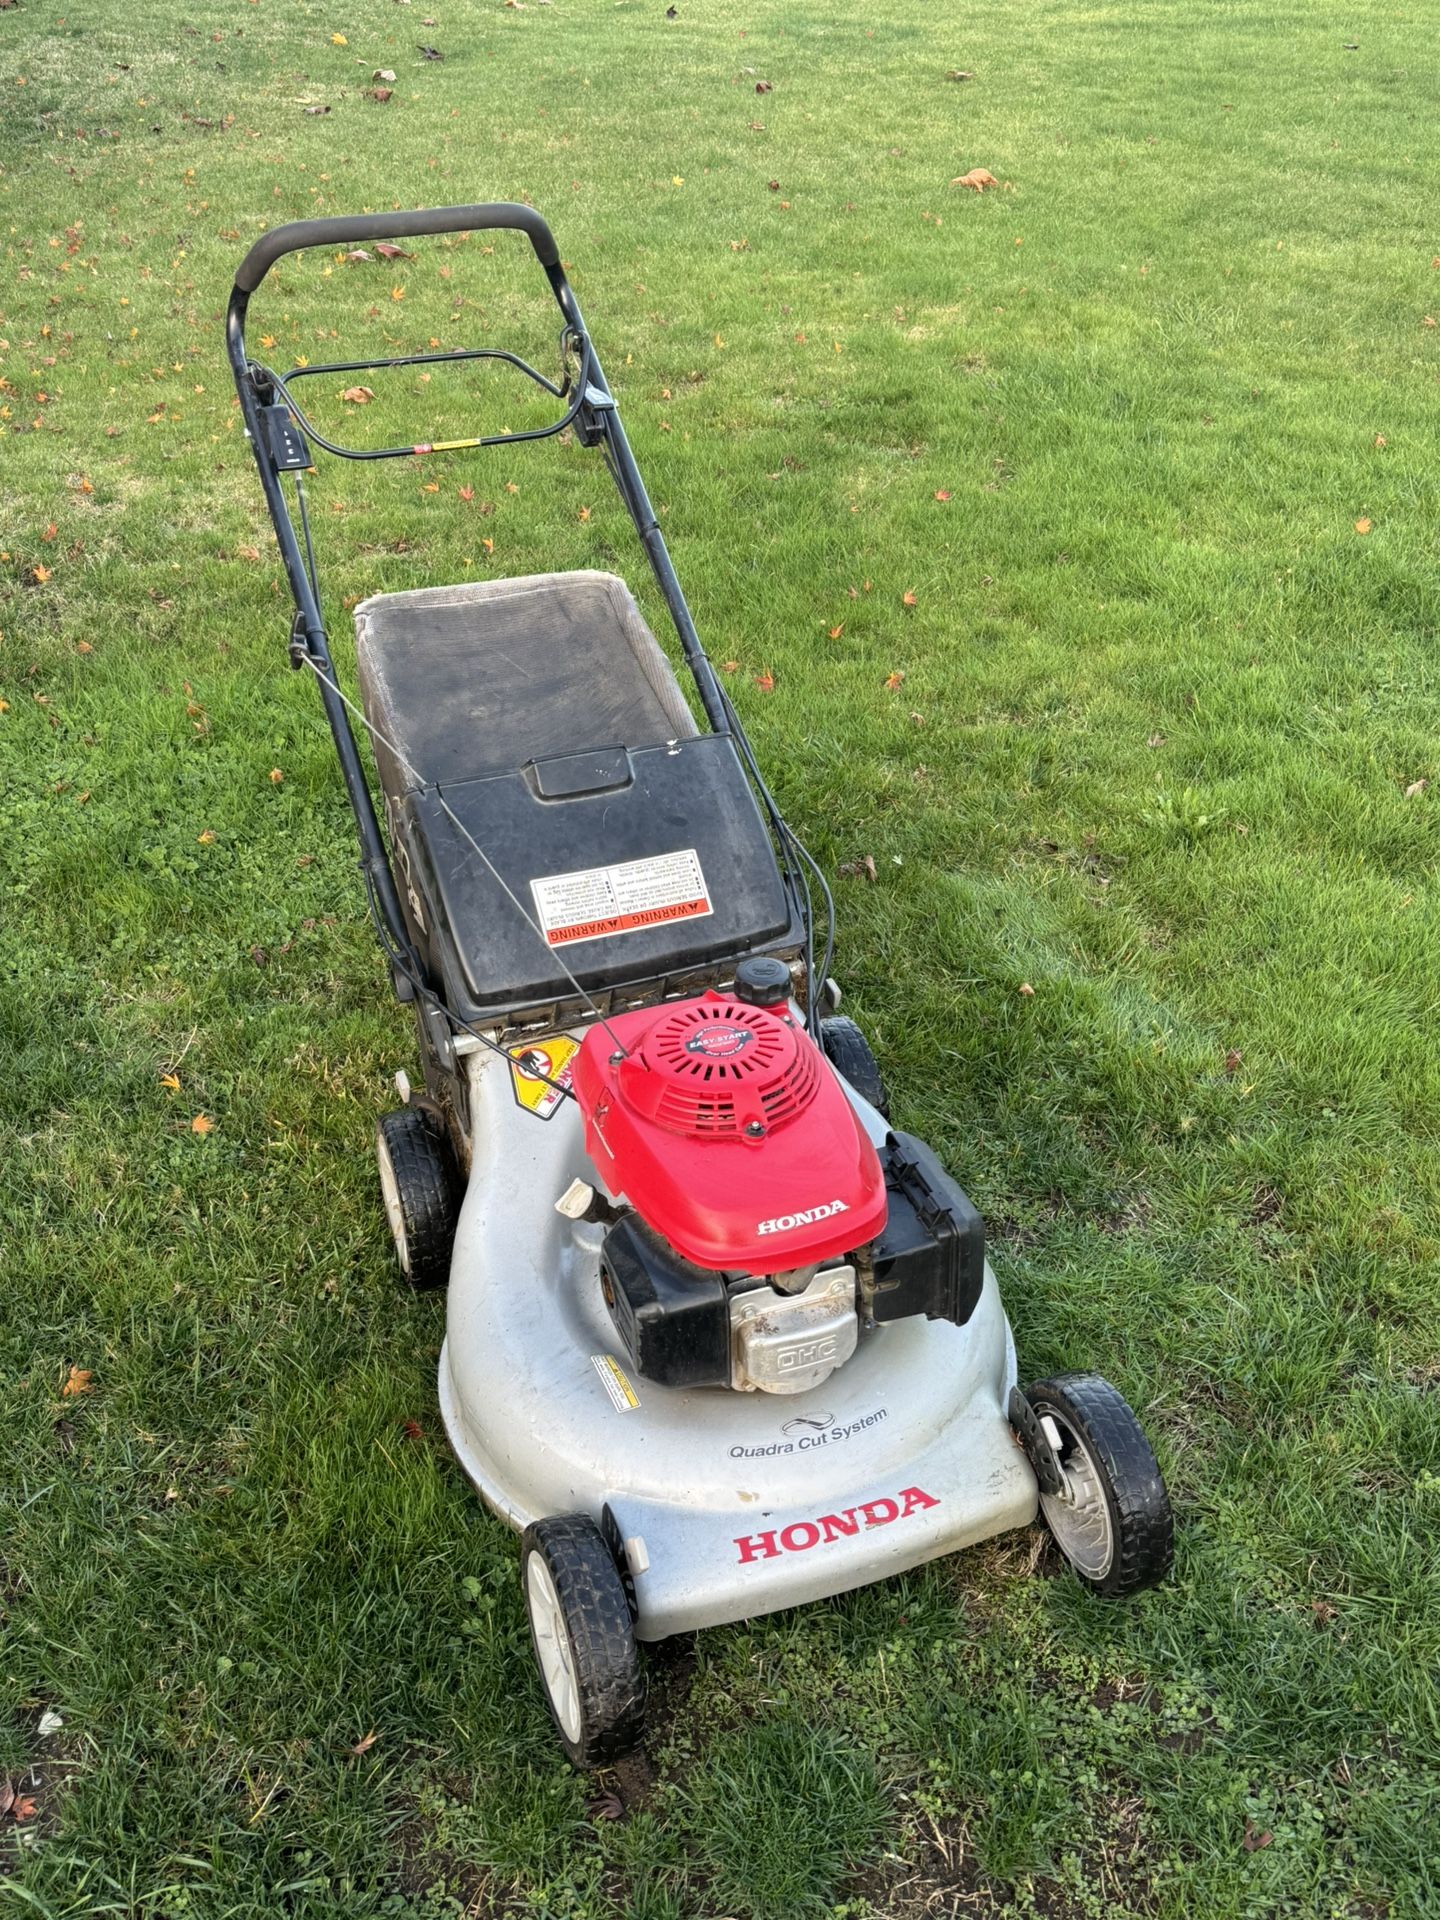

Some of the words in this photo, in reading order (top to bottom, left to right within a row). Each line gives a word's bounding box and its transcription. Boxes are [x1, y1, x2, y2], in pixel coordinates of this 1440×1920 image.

[631, 904, 687, 924] WARNING
[549, 921, 606, 941] WARNING
[689, 1038, 715, 1048] EASY
[717, 1031, 748, 1041] START
[757, 1199, 850, 1235] HONDA
[777, 1340, 837, 1369] OHC
[730, 1443, 794, 1458] Quadra
[798, 1433, 827, 1450] Cut
[831, 1407, 888, 1440] System
[733, 1486, 941, 1564] HONDA
